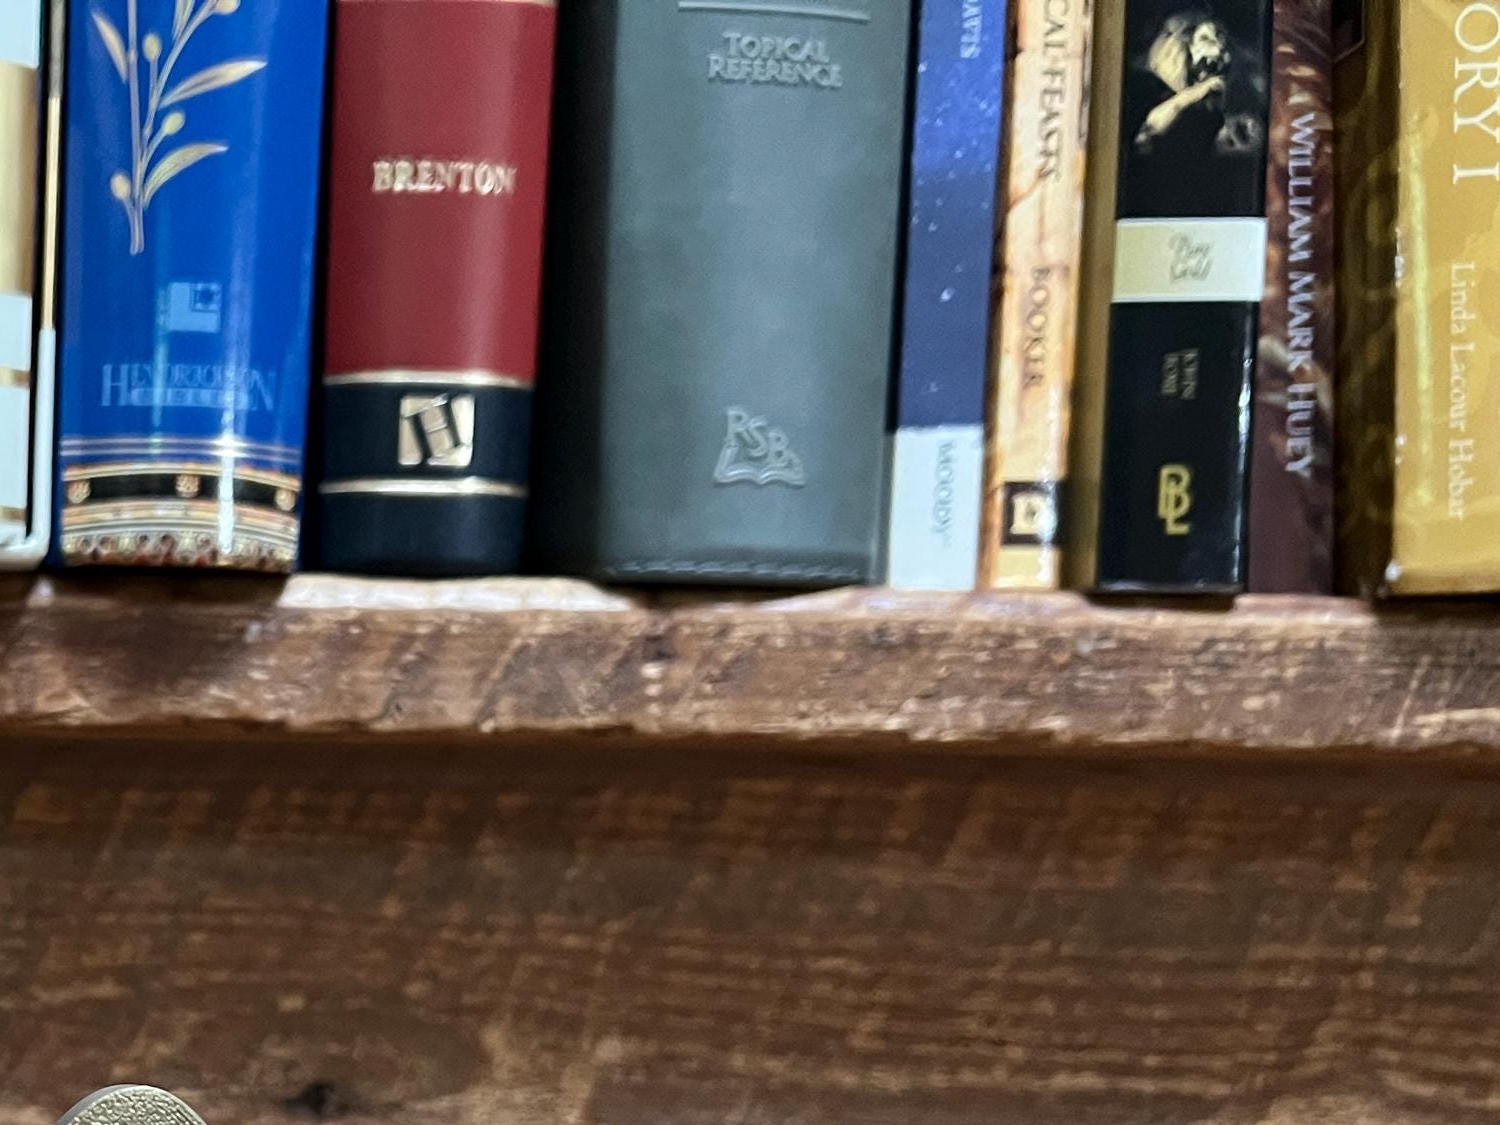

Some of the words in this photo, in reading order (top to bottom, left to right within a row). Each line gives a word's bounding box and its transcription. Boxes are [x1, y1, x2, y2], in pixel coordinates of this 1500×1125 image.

[708, 53, 843, 88] REFERENCE
[722, 30, 831, 64] TOPICAL
[1453, 3, 1500, 143] ORY
[372, 159, 518, 196] BRENTON
[1288, 112, 1316, 262] WILLIAM
[1287, 271, 1316, 371] MARK
[1450, 261, 1477, 335] Linda
[1286, 383, 1316, 479] HUEY
[1449, 342, 1476, 432] Lacour
